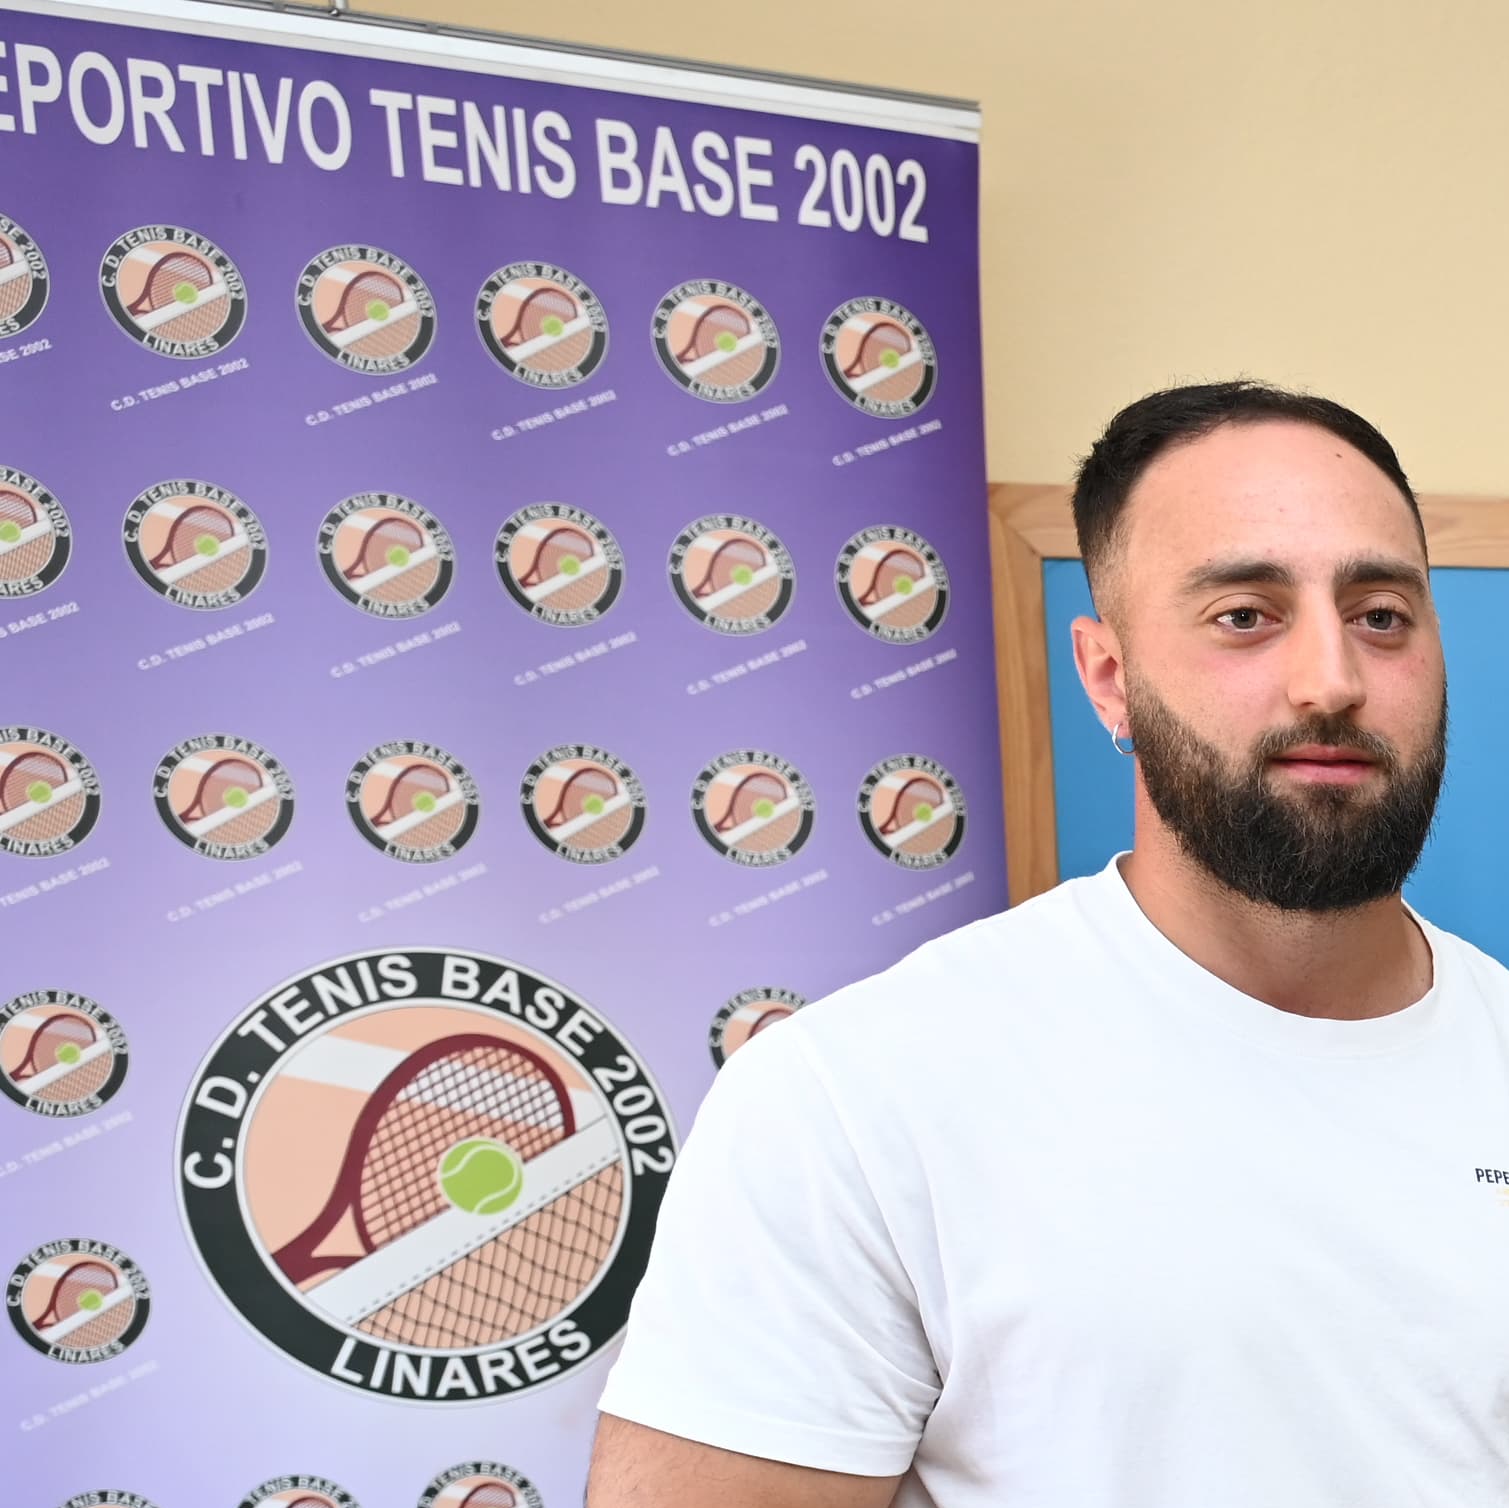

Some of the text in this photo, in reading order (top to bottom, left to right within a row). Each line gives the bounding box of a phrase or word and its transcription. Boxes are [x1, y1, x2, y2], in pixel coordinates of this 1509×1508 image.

[369, 88, 577, 199] TENIS
[595, 118, 779, 222] BASE
[794, 144, 929, 243] 2002
[117, 228, 167, 252] TENIS
[173, 228, 221, 260] BASE
[220, 263, 244, 300] 2002
[313, 247, 361, 271] TENIS
[366, 249, 413, 280] BASE
[411, 281, 434, 317] 2002
[142, 335, 219, 356] LINARES
[179, 368, 218, 388] BASE
[337, 352, 410, 371] LINARES
[140, 482, 189, 507] TENIS
[195, 483, 244, 514] BASE
[242, 515, 266, 550] 2002
[165, 585, 241, 607] LINARES
[238, 954, 417, 1056] TENIS
[441, 955, 603, 1055] BASE
[595, 1055, 675, 1176] 2002
[331, 1318, 590, 1396] LINARES
